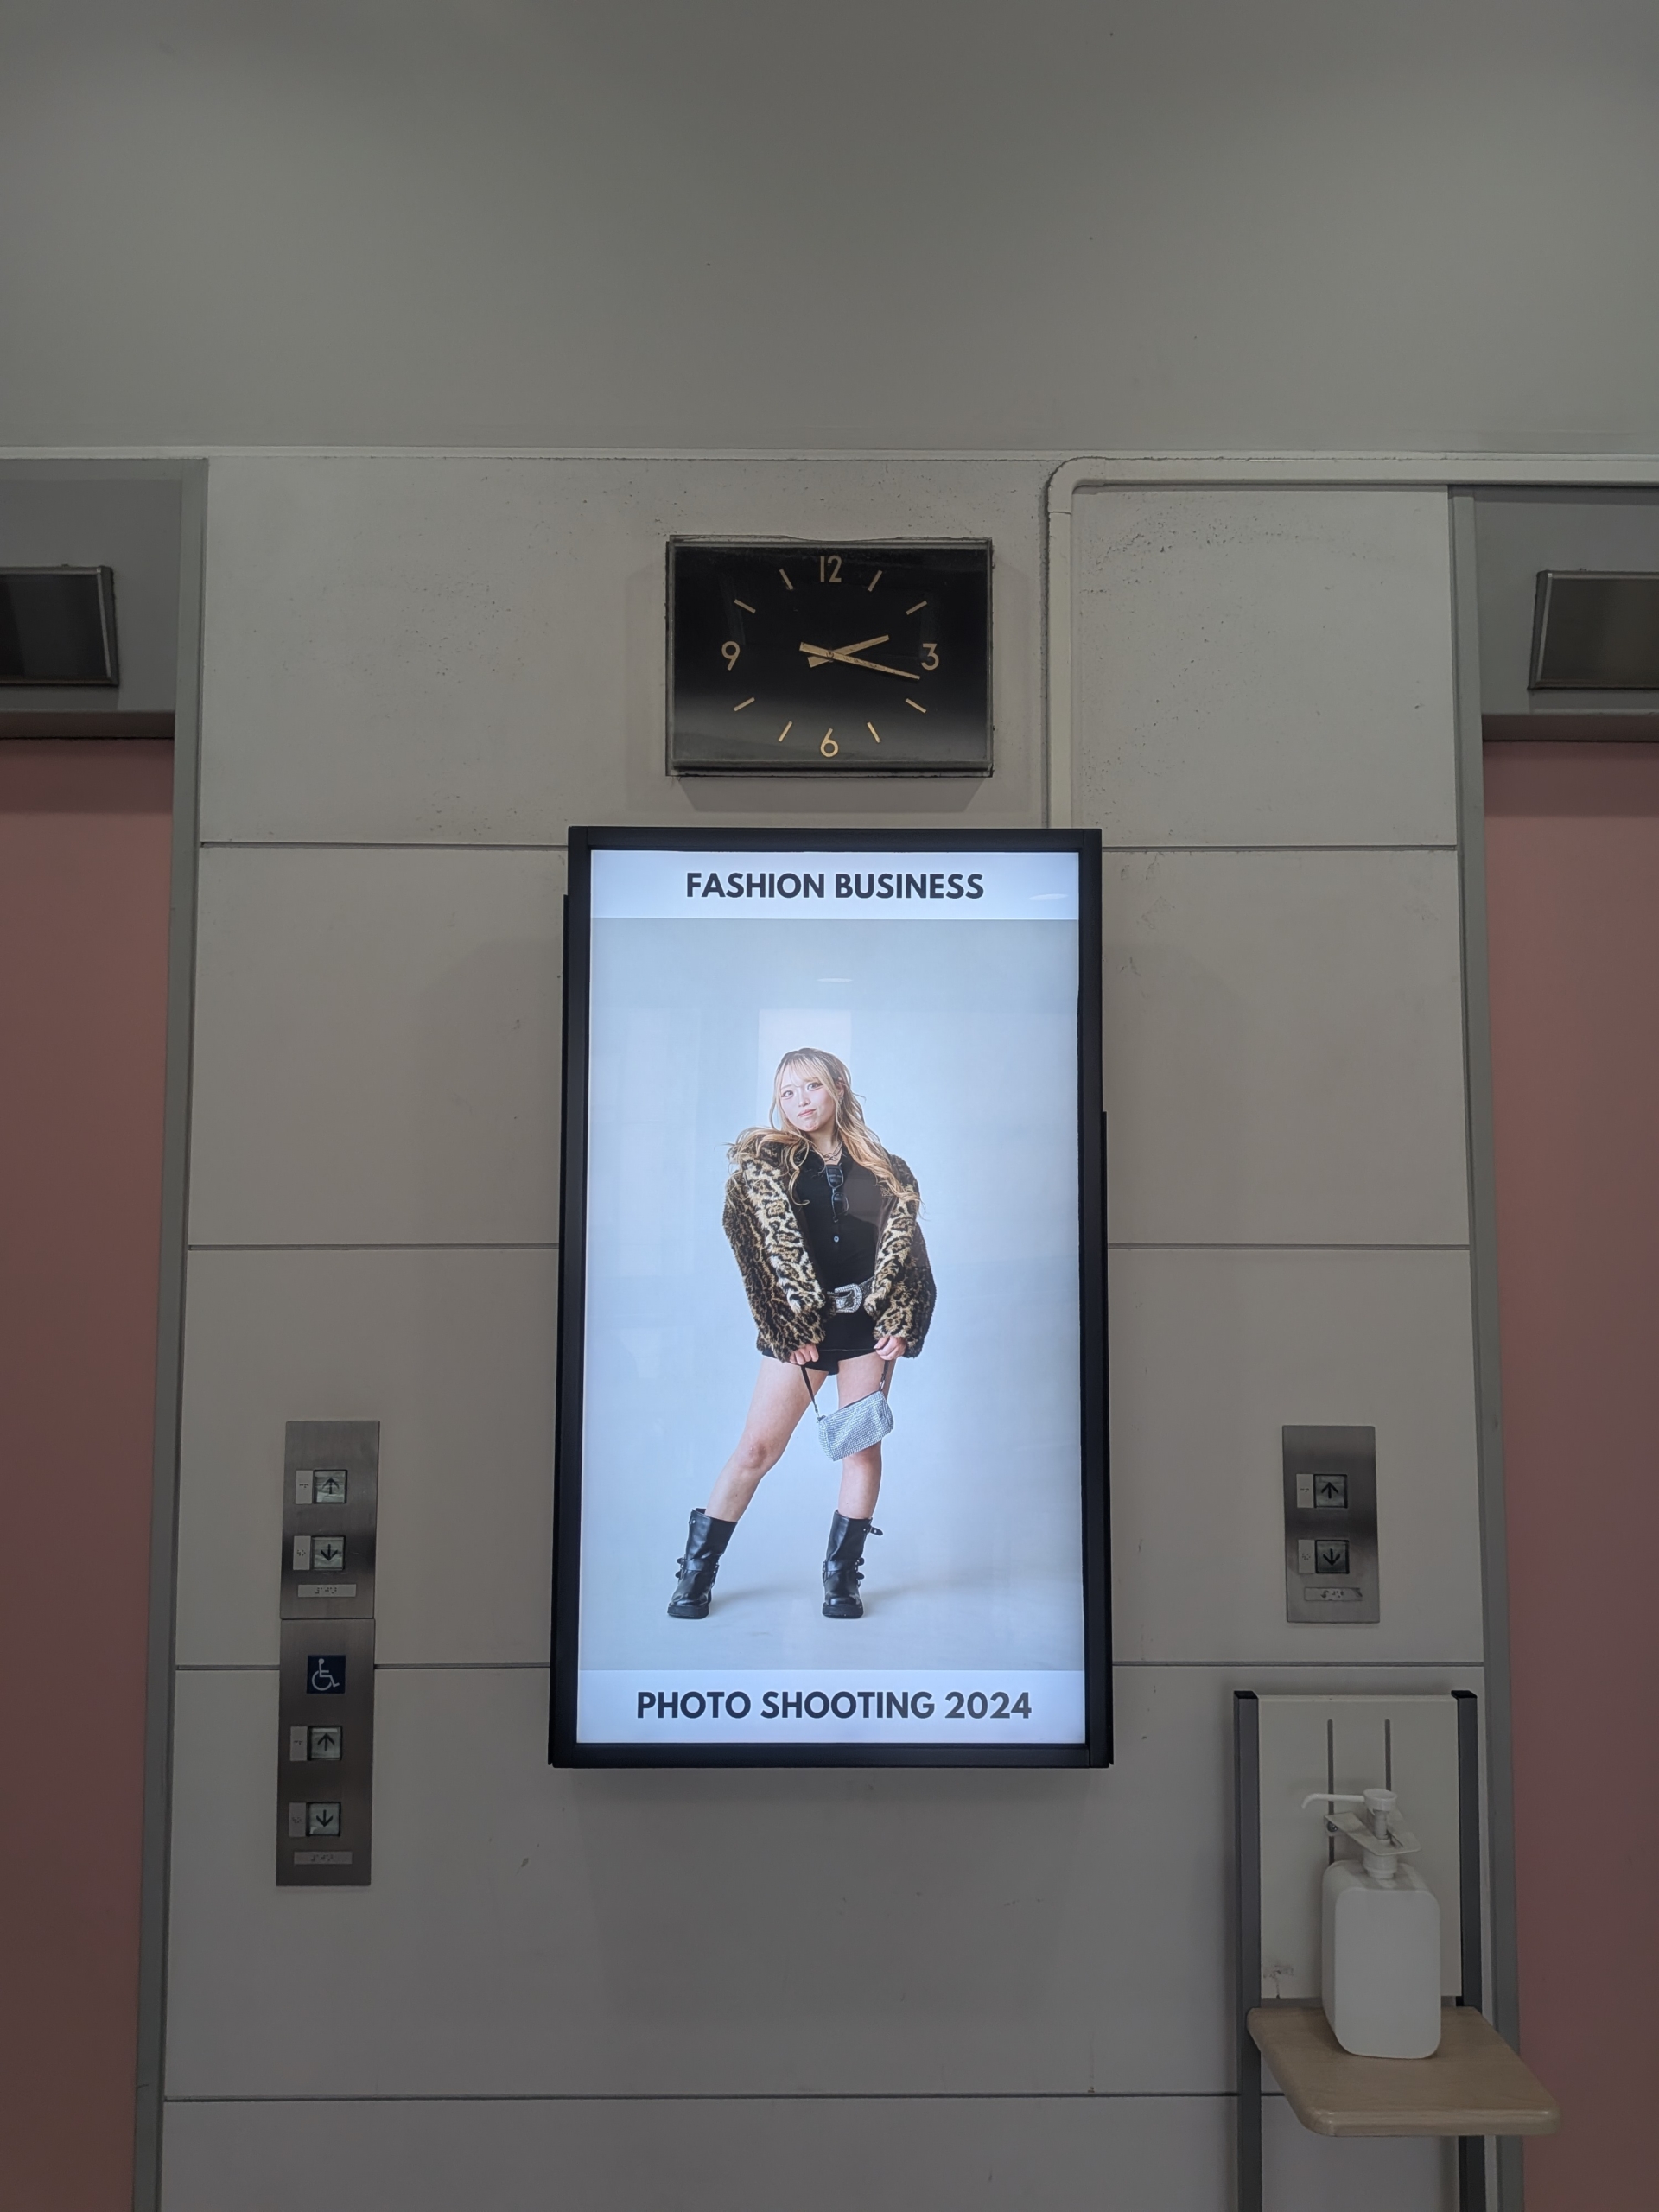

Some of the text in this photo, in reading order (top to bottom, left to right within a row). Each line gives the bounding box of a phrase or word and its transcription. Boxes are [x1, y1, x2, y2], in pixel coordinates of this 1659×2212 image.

[819, 554, 842, 583] 12
[721, 640, 741, 671] 9
[920, 642, 940, 671] 3
[820, 728, 839, 758] 6
[686, 872, 984, 899] FASHION BUSINESS
[637, 1691, 1032, 1719] PHOTO SHOOTING 2024
